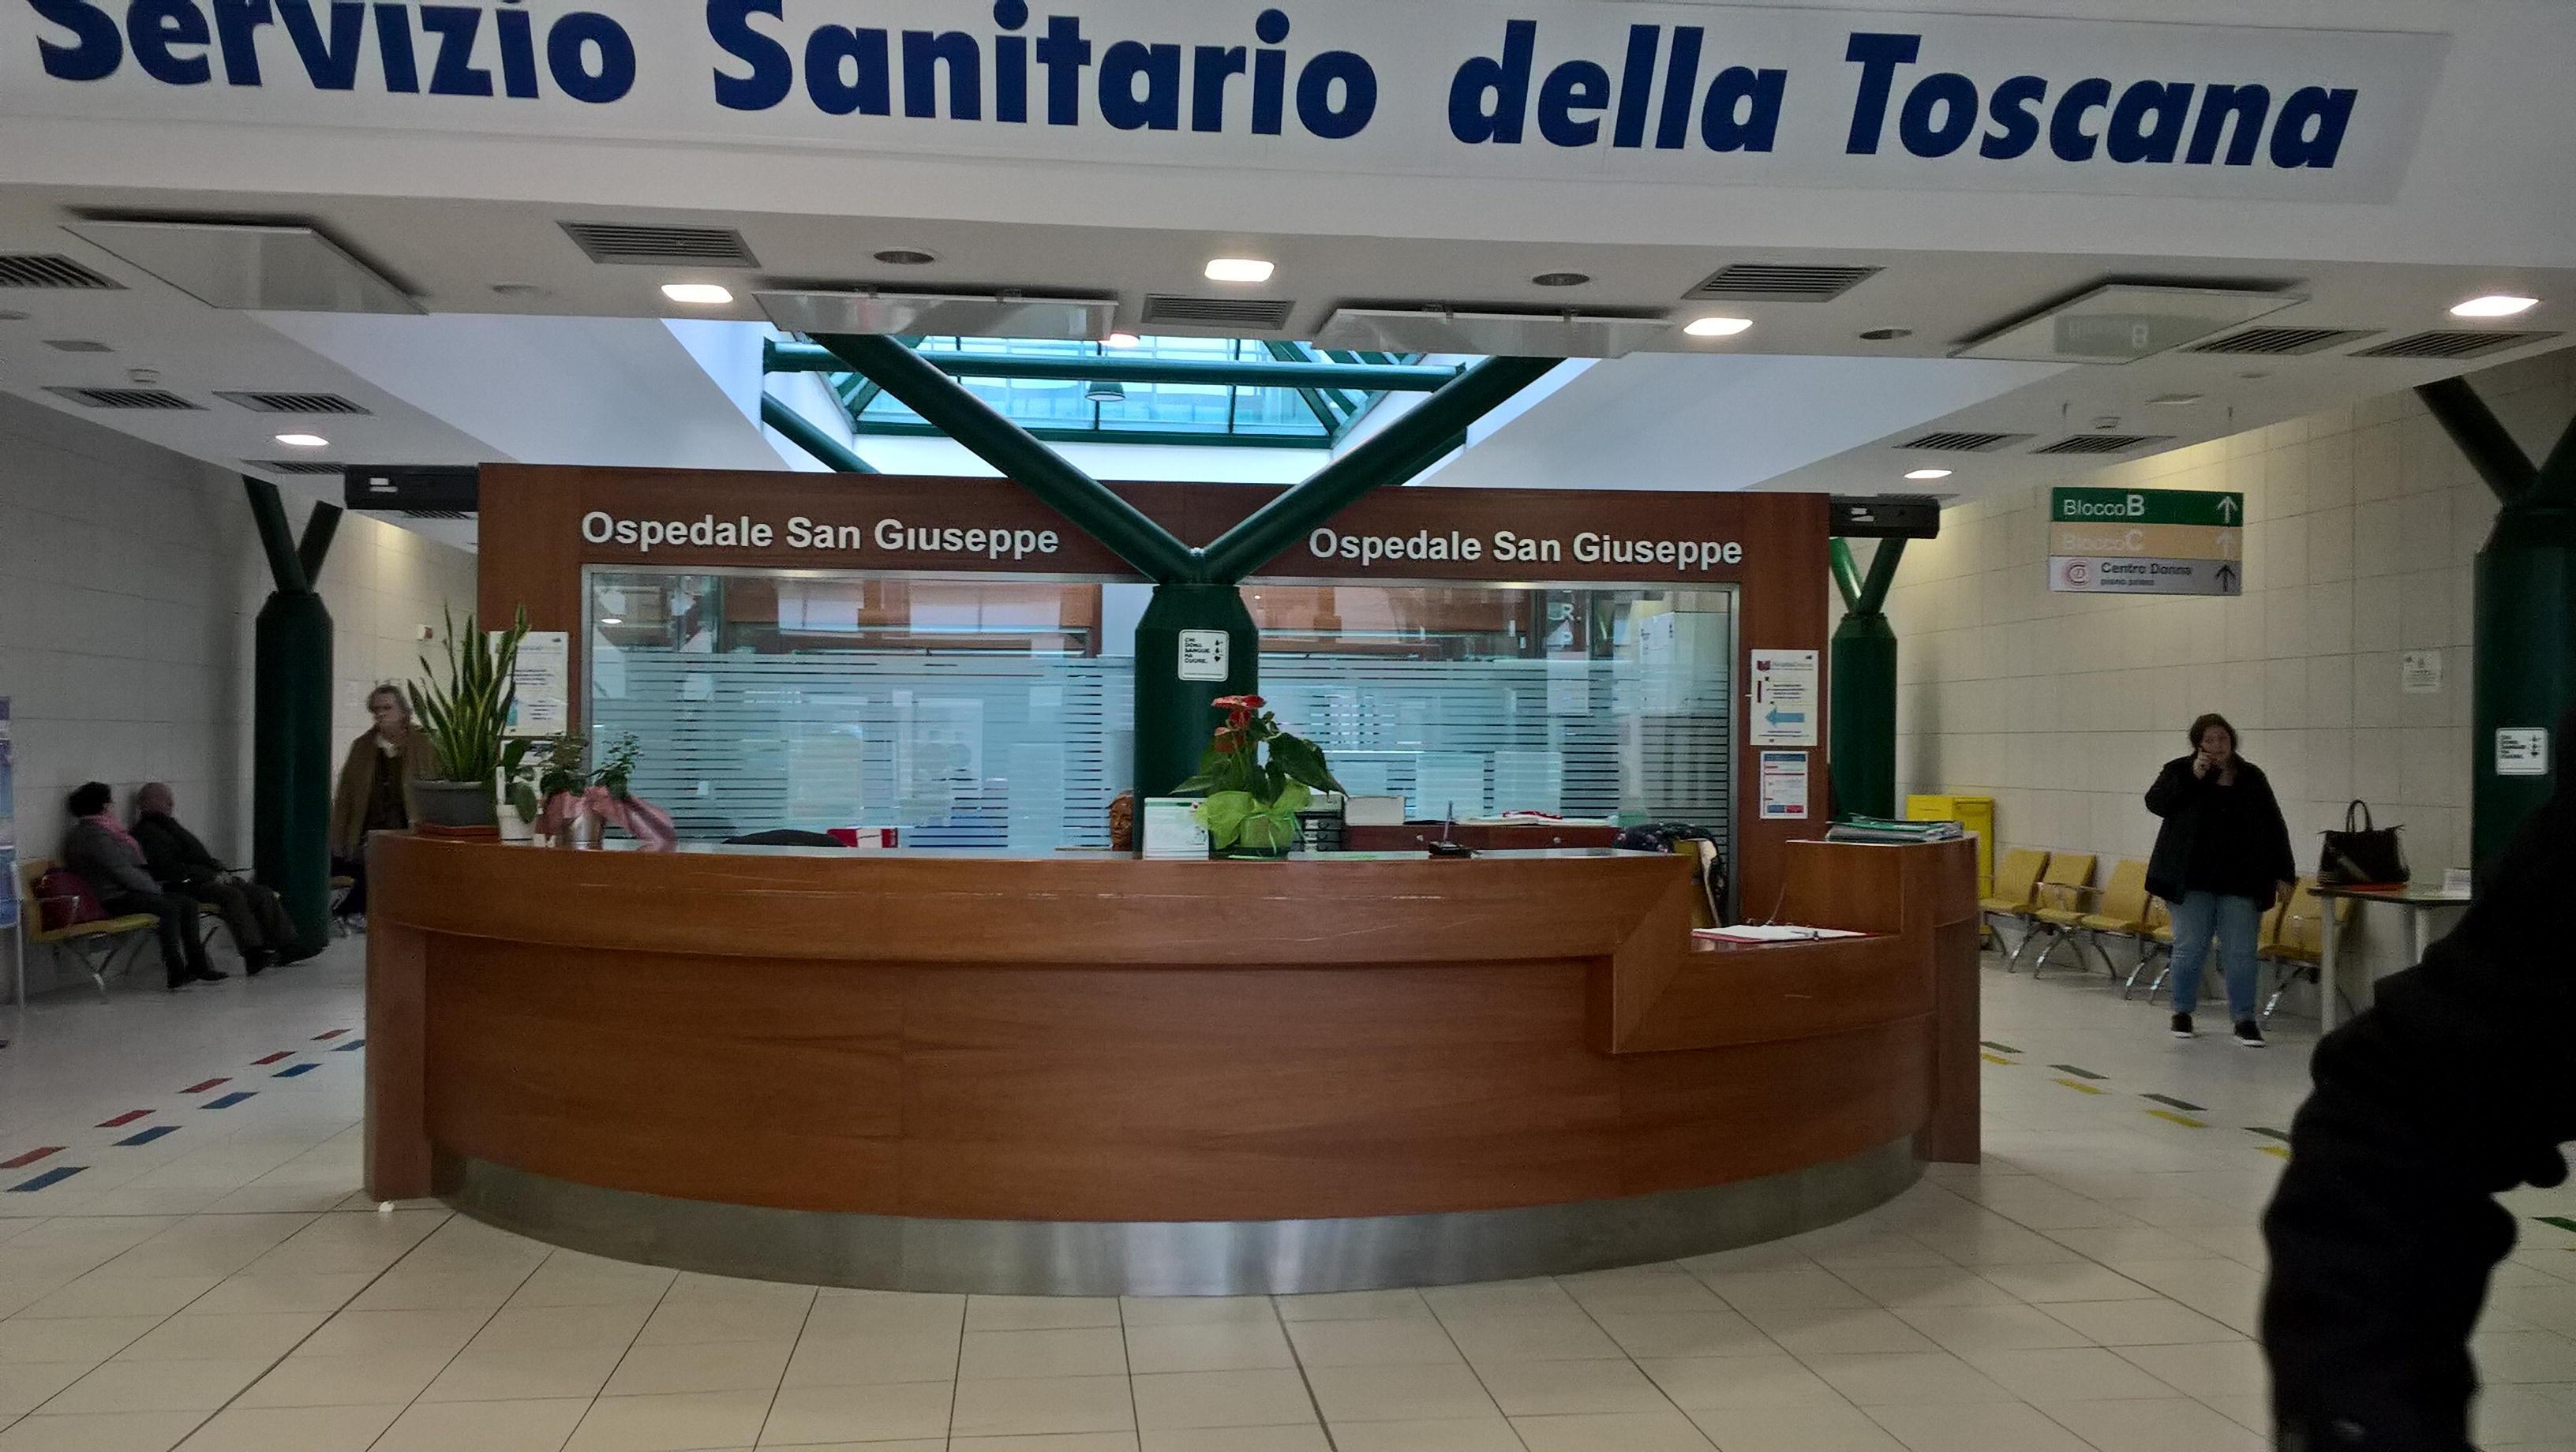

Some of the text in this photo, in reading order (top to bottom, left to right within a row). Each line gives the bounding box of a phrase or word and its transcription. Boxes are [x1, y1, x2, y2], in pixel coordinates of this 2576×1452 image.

[27, 0, 2359, 169] Servizio Sanitario della Toscana
[582, 511, 1059, 560] Ospedale San Giuseppe
[1309, 528, 1743, 571] Ospedale San Giuseppe
[2101, 562, 2193, 576] Centro Donna
